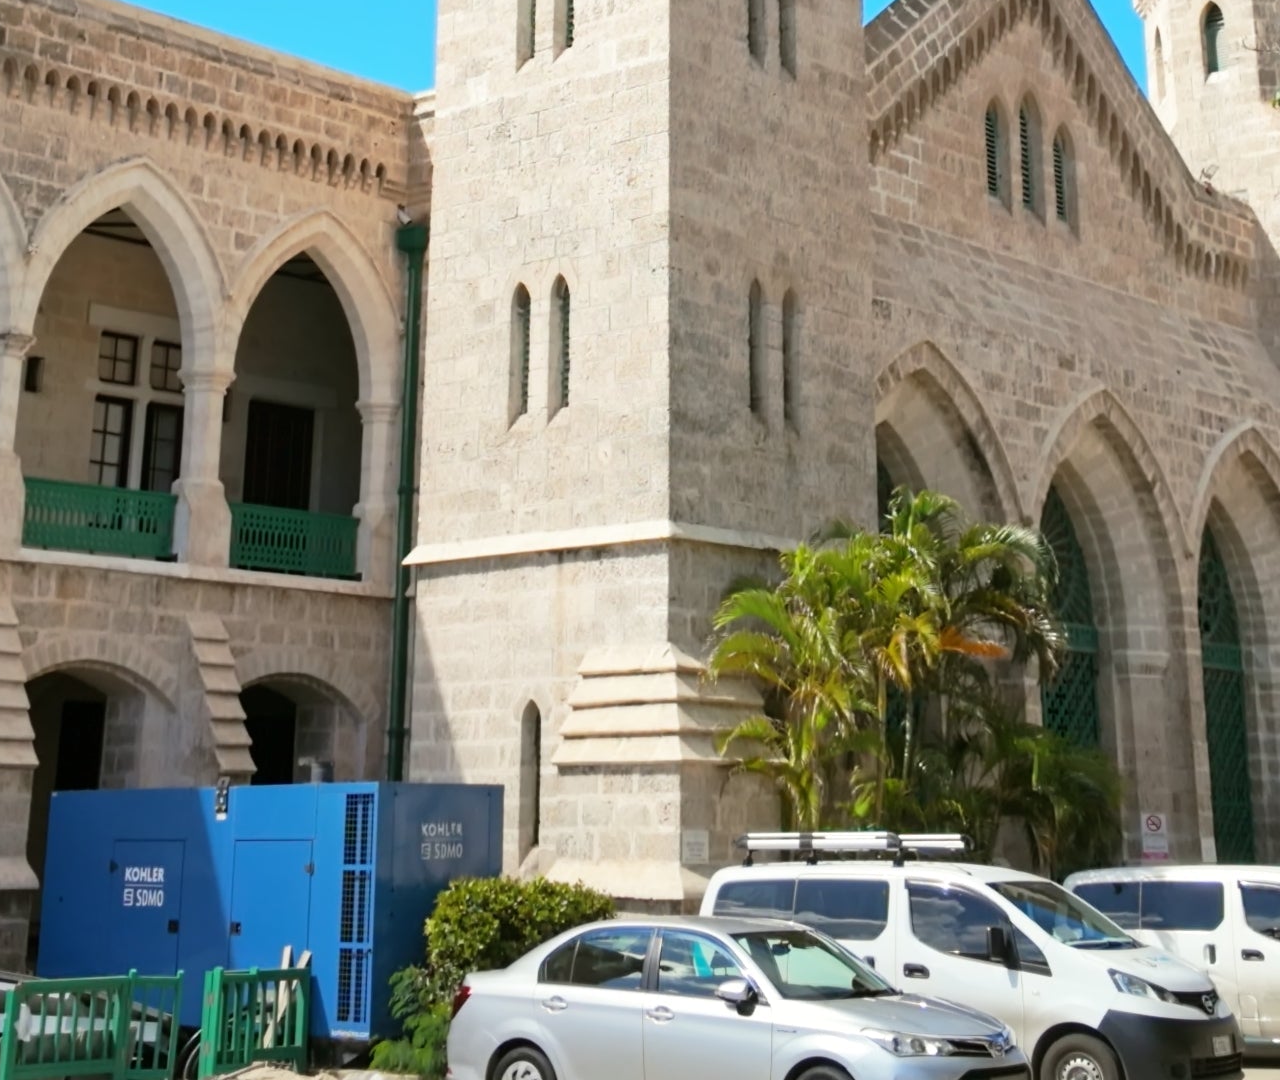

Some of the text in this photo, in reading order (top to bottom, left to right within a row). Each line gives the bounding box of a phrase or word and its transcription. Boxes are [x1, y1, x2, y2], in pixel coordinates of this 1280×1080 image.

[421, 822, 462, 837] KOHLER
[434, 843, 463, 859] SDMO
[124, 867, 164, 882] KOHLER
[135, 889, 164, 907] SDMO
